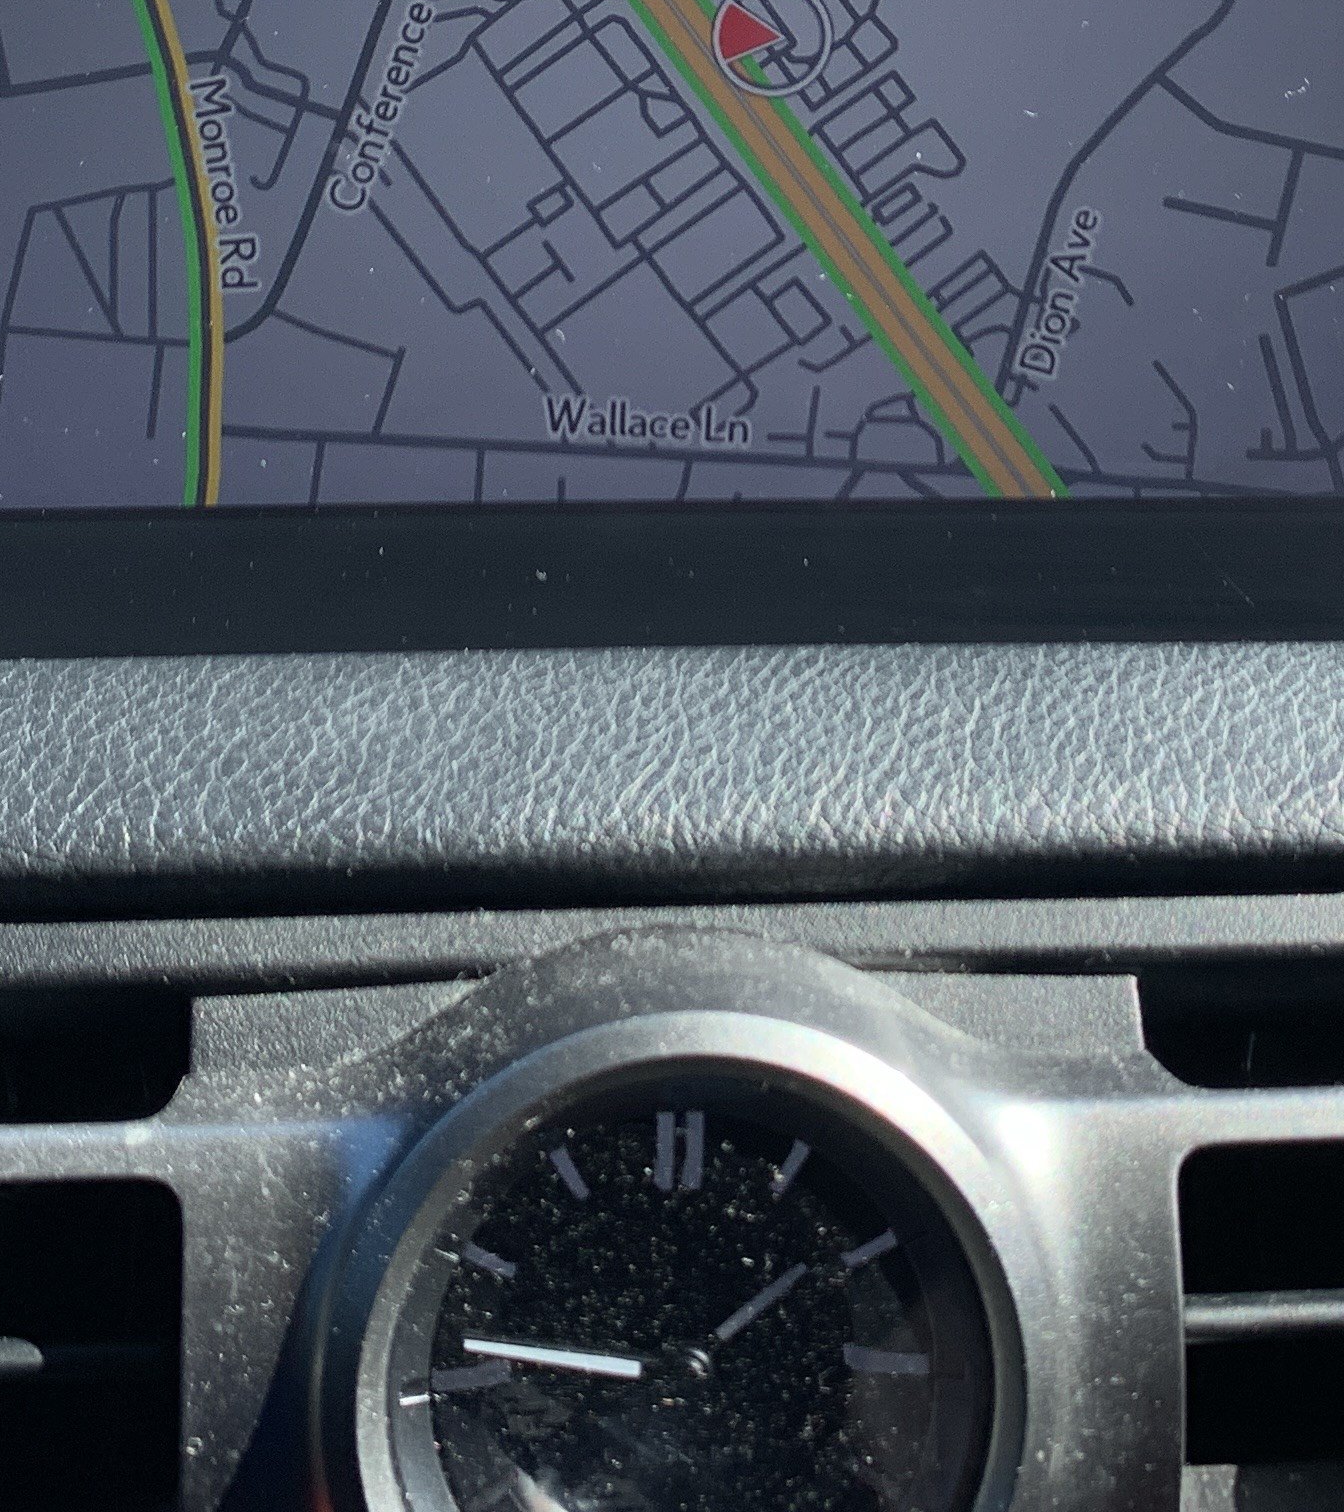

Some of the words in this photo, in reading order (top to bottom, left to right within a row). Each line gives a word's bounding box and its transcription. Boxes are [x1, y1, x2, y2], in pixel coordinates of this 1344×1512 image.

[189, 76, 239, 225] Monroe
[219, 237, 258, 290] Rd
[329, 1, 433, 211] Conference
[1019, 291, 1074, 376] Dion
[1049, 209, 1098, 283] Ave
[546, 396, 692, 440] Wallace
[705, 405, 750, 443] Ln
